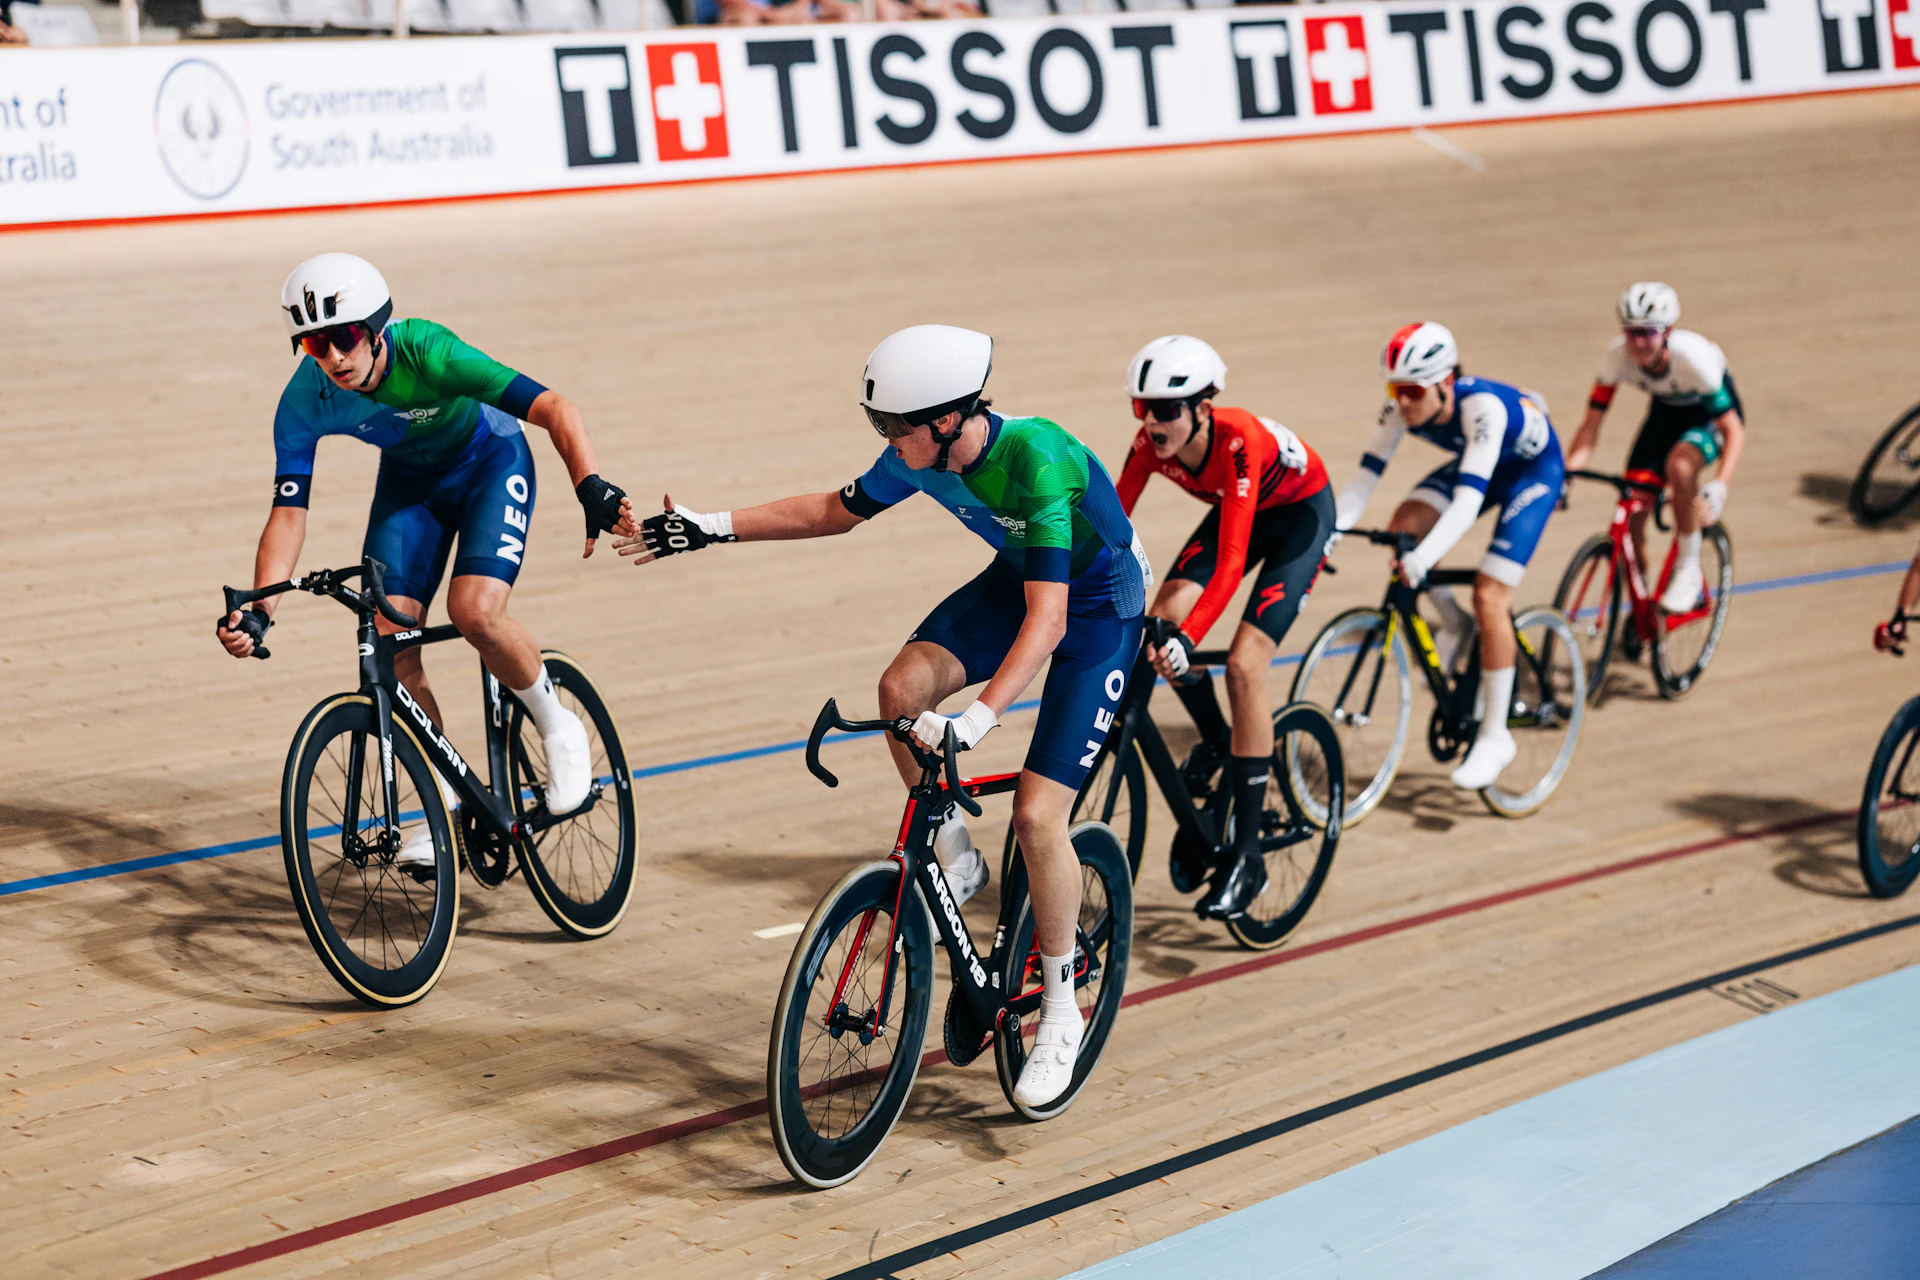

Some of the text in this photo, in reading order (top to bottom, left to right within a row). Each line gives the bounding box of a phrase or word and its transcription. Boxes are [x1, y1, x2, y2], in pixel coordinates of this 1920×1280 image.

[265, 72, 489, 120] Government of
[745, 25, 1176, 153] TISSOT
[1388, 0, 1767, 106] TISSOT
[36, 86, 68, 127] of
[271, 123, 495, 171] South Australia
[496, 474, 529, 566] NEO
[394, 629, 422, 641] DOLAN
[382, 733, 393, 783] WING
[395, 681, 468, 778] DOLAN
[1079, 669, 1125, 769] NEO
[926, 861, 988, 989] ARGON 18
